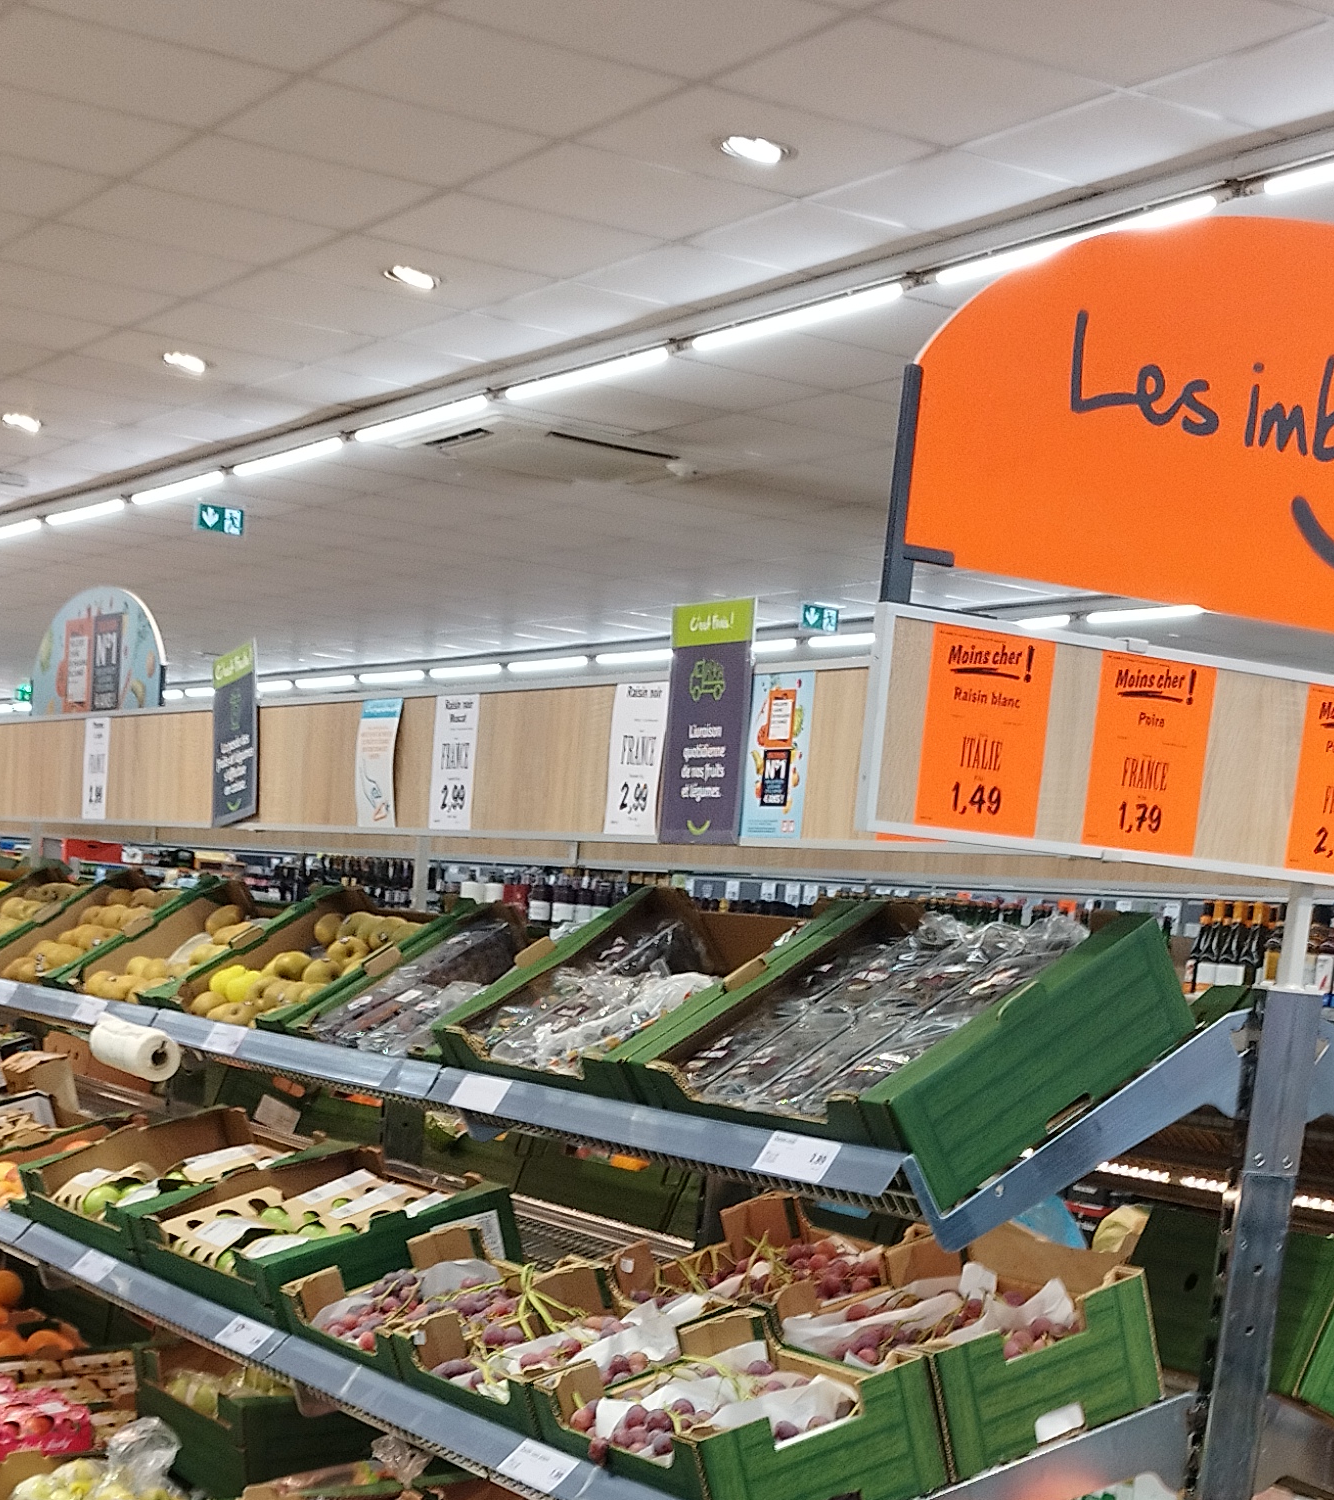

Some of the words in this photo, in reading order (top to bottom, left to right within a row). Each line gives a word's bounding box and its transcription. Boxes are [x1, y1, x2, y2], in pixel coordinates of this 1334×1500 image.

[1070, 309, 1219, 437] Les
[948, 644, 990, 665] Moins
[1115, 669, 1157, 689] Moins
[954, 687, 988, 706] Raisin
[992, 691, 1021, 709] blanc
[1138, 712, 1165, 728] Poire
[959, 736, 1003, 772] ITALIE
[1121, 756, 1170, 791] FRANCE
[619, 782, 648, 814] 2,99
[951, 781, 1002, 816] 1,49
[1118, 801, 1163, 834] 1,79
